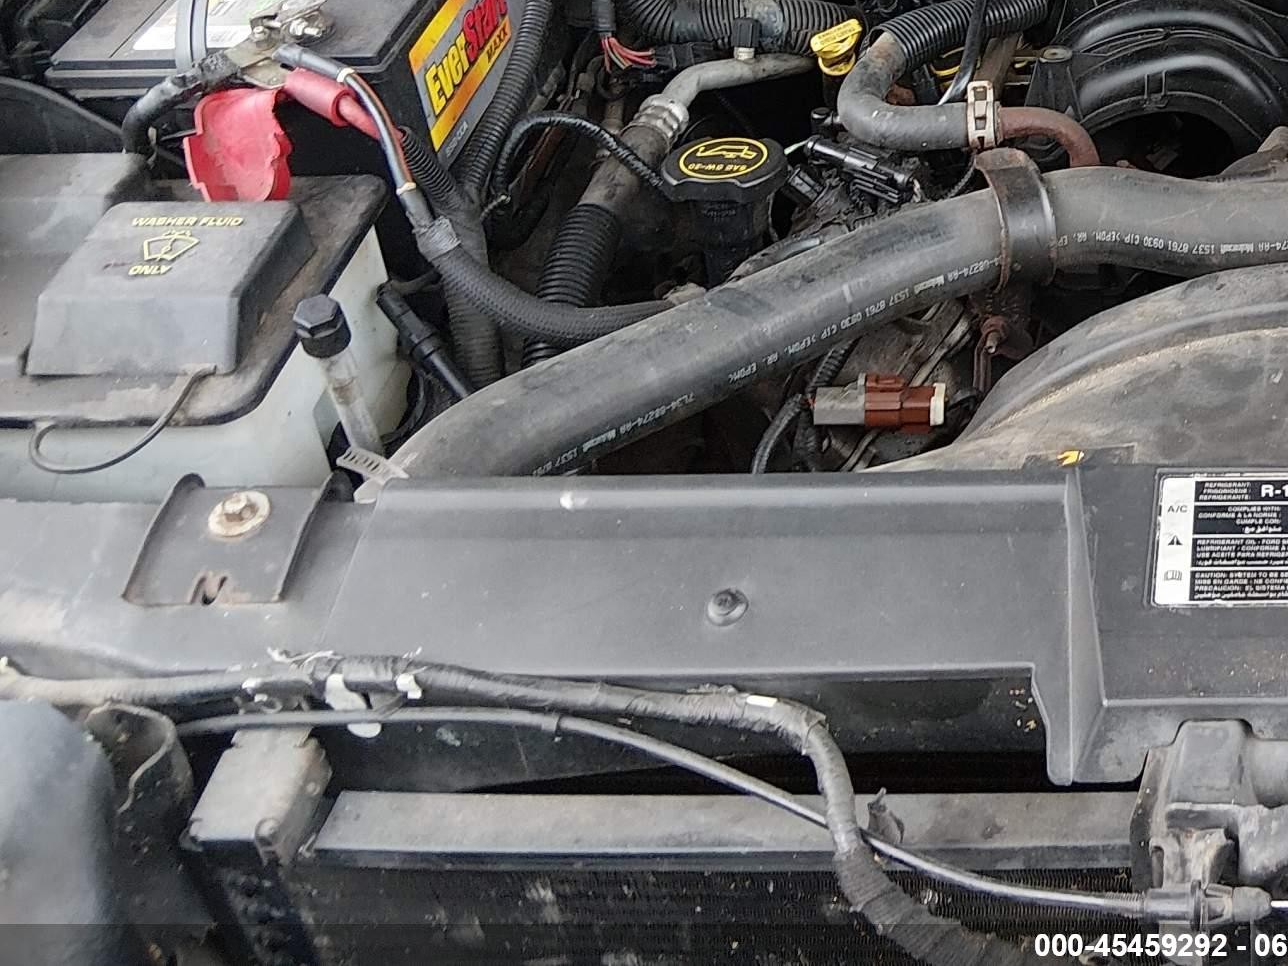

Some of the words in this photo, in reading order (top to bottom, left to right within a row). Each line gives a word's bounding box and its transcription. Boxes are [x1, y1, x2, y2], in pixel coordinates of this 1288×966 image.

[486, 26, 509, 62] MAXX
[131, 217, 198, 227] WASHER
[199, 217, 244, 227] FLUID
[1143, 236, 1164, 249] 0930
[1167, 240, 1190, 254] 8761
[1192, 242, 1215, 254] 1537
[128, 265, 173, 275] ONLY
[1167, 505, 1188, 514] A/C
